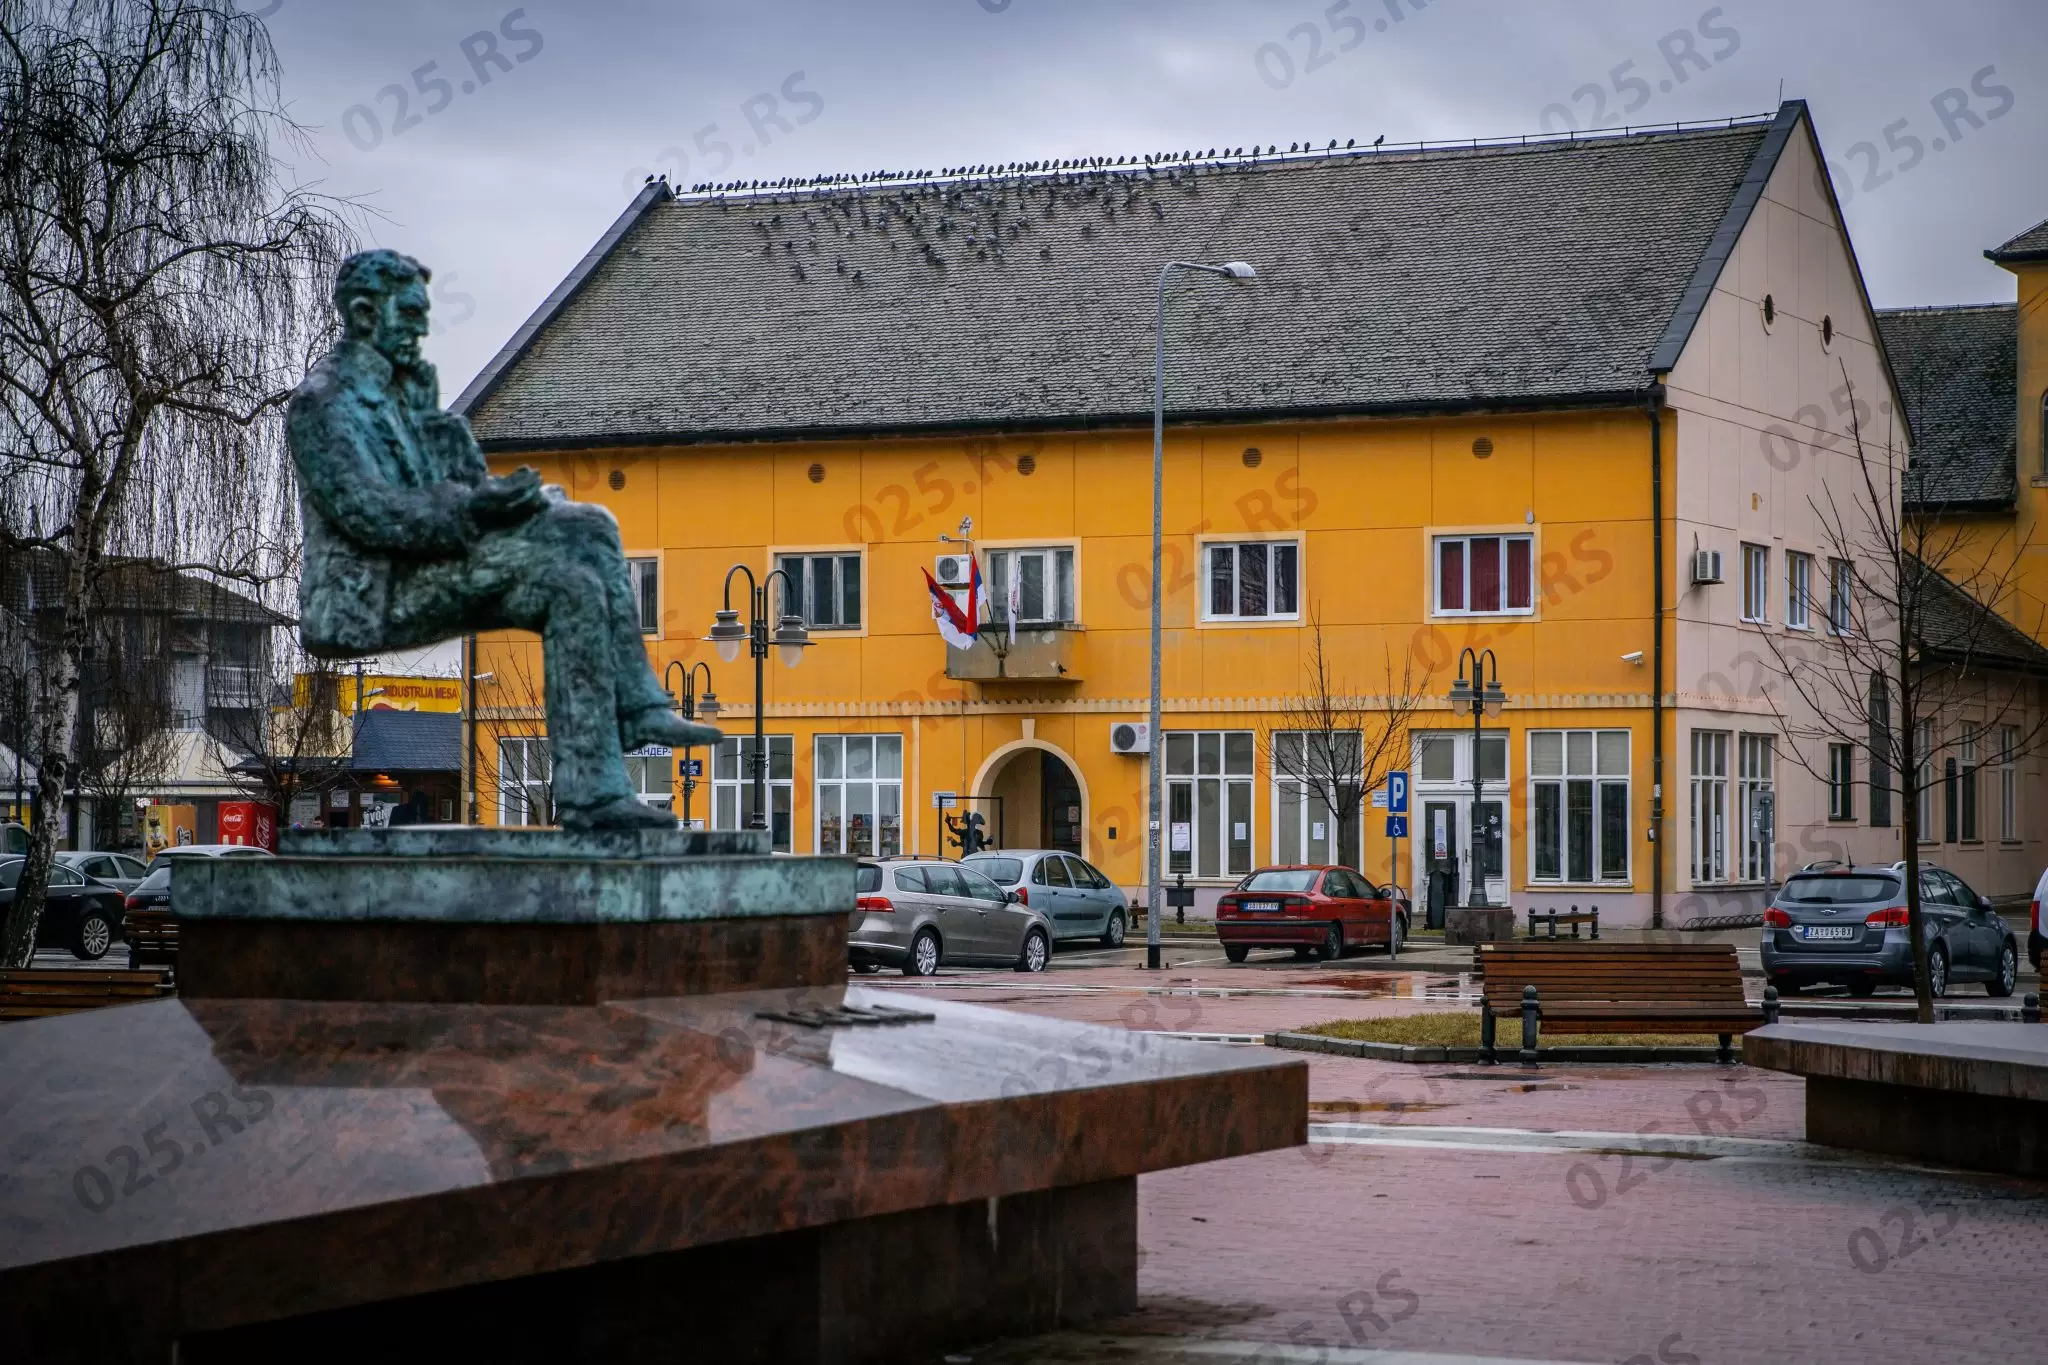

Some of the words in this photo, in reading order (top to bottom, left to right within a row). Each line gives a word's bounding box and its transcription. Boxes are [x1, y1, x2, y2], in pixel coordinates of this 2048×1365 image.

[382, 685, 434, 698] INDUSTRIJA
[435, 686, 457, 699] MESA
[628, 747, 671, 757] ЕАНДЕР-
[1393, 777, 1404, 807] P
